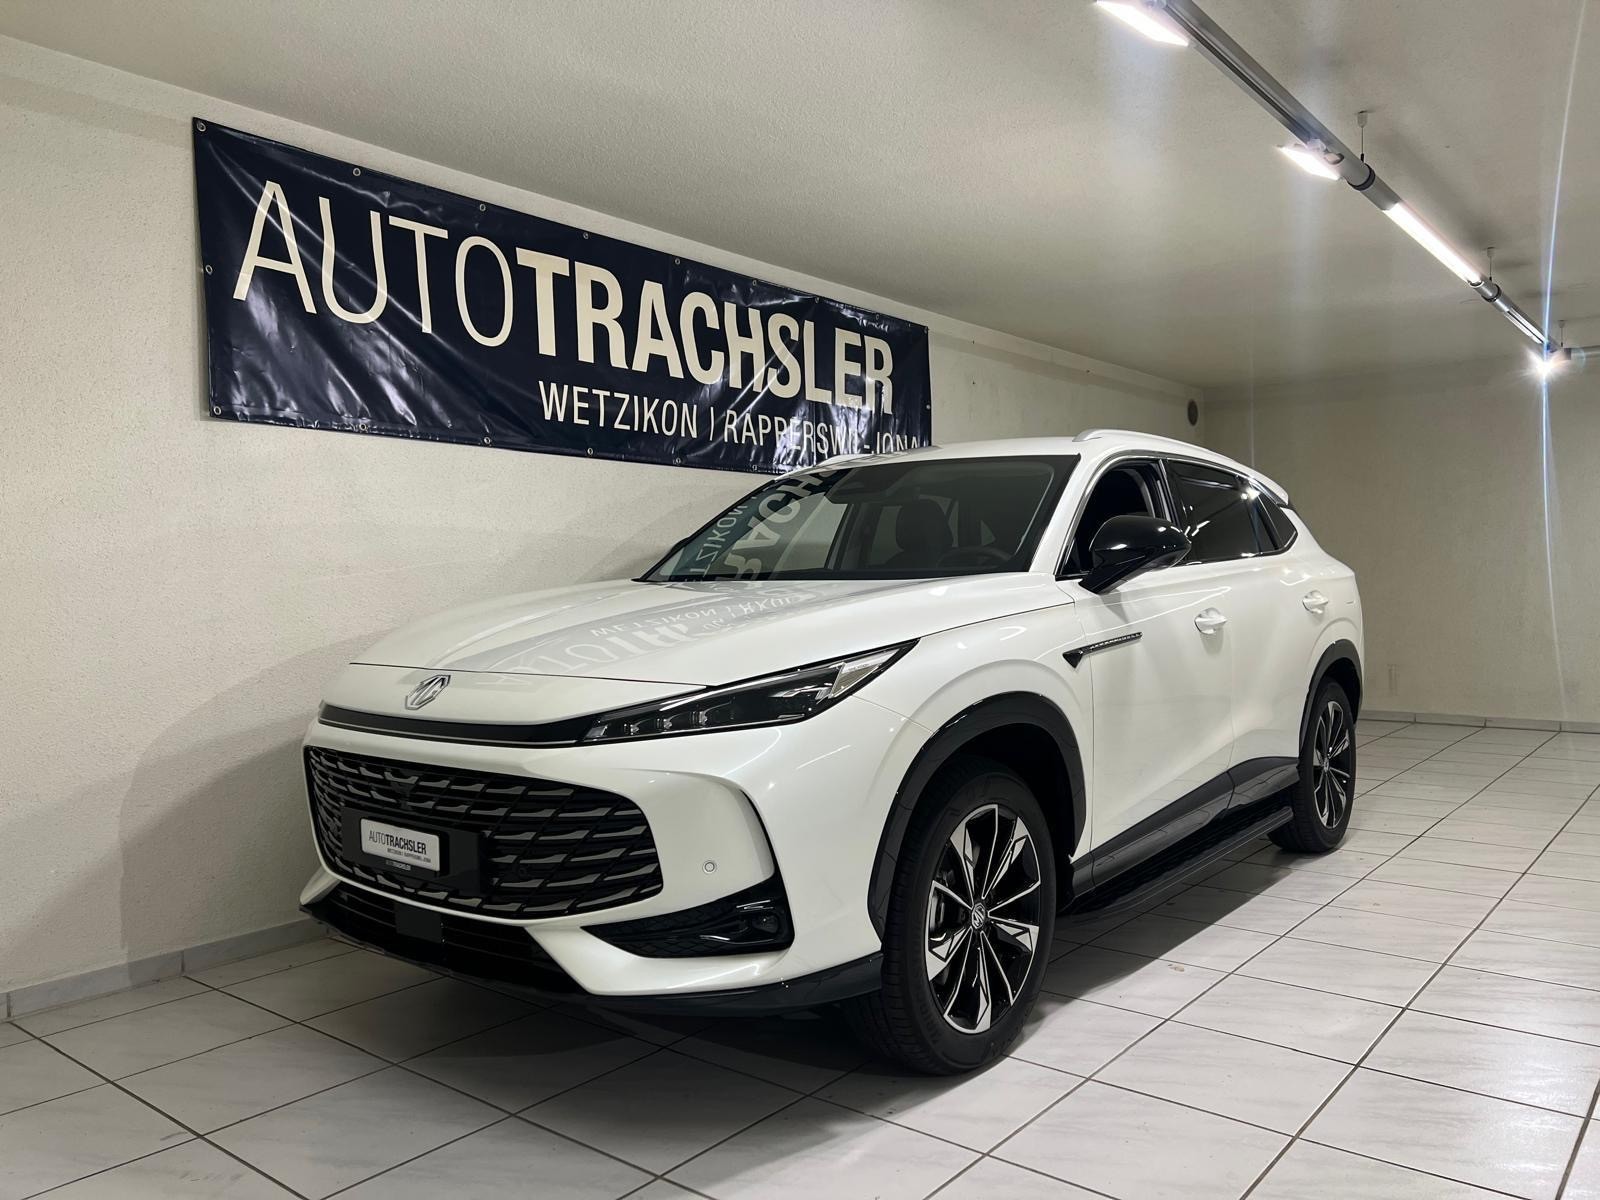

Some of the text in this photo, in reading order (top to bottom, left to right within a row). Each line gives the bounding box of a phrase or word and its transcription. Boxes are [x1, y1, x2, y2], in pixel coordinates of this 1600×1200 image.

[233, 180, 893, 415] AUTOTRACHSLER
[538, 381, 697, 440] WETZIKON
[368, 830, 427, 855] AUTOTRACHSLER
